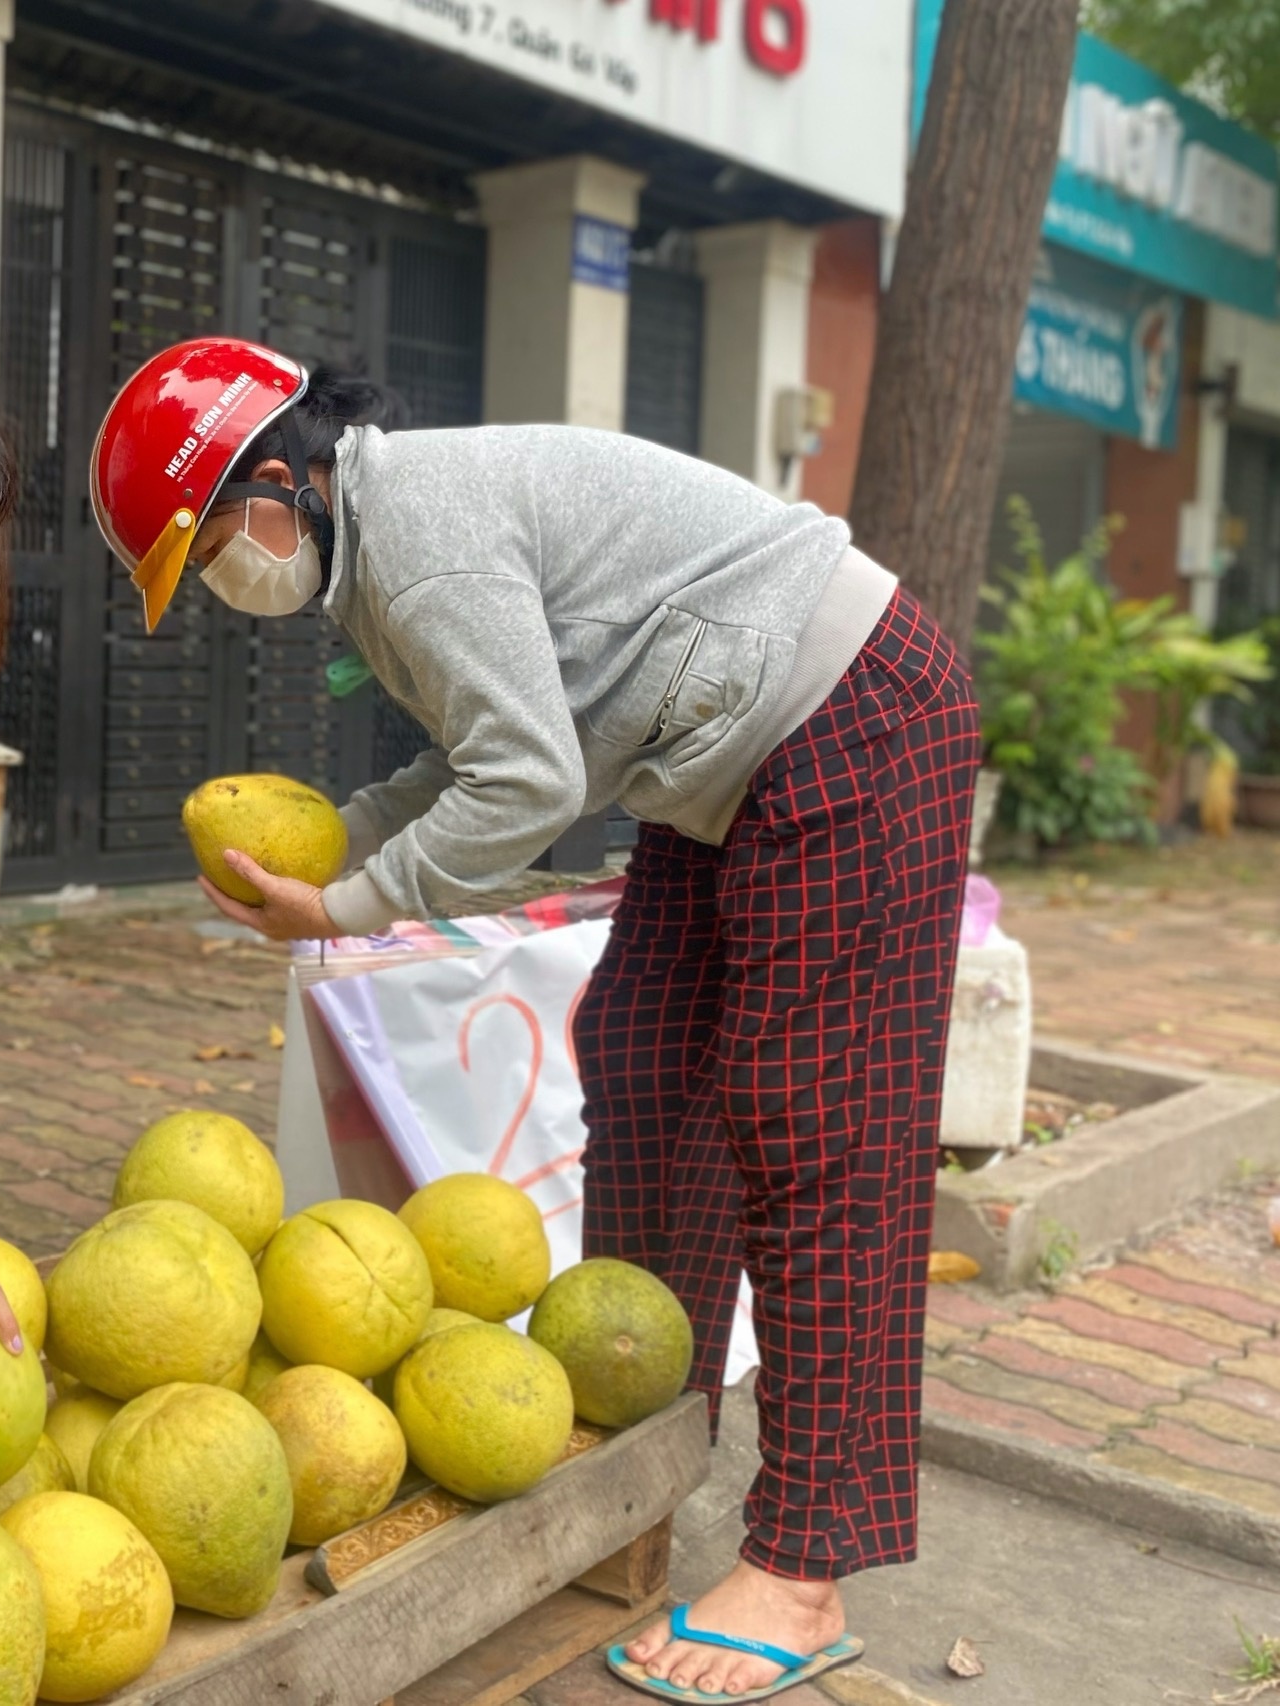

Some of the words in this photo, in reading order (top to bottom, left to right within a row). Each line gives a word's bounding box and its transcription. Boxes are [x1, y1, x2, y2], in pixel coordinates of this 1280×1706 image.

[164, 436, 198, 478] HEAD
[194, 405, 223, 437] SƠN
[218, 372, 253, 407] MINH
